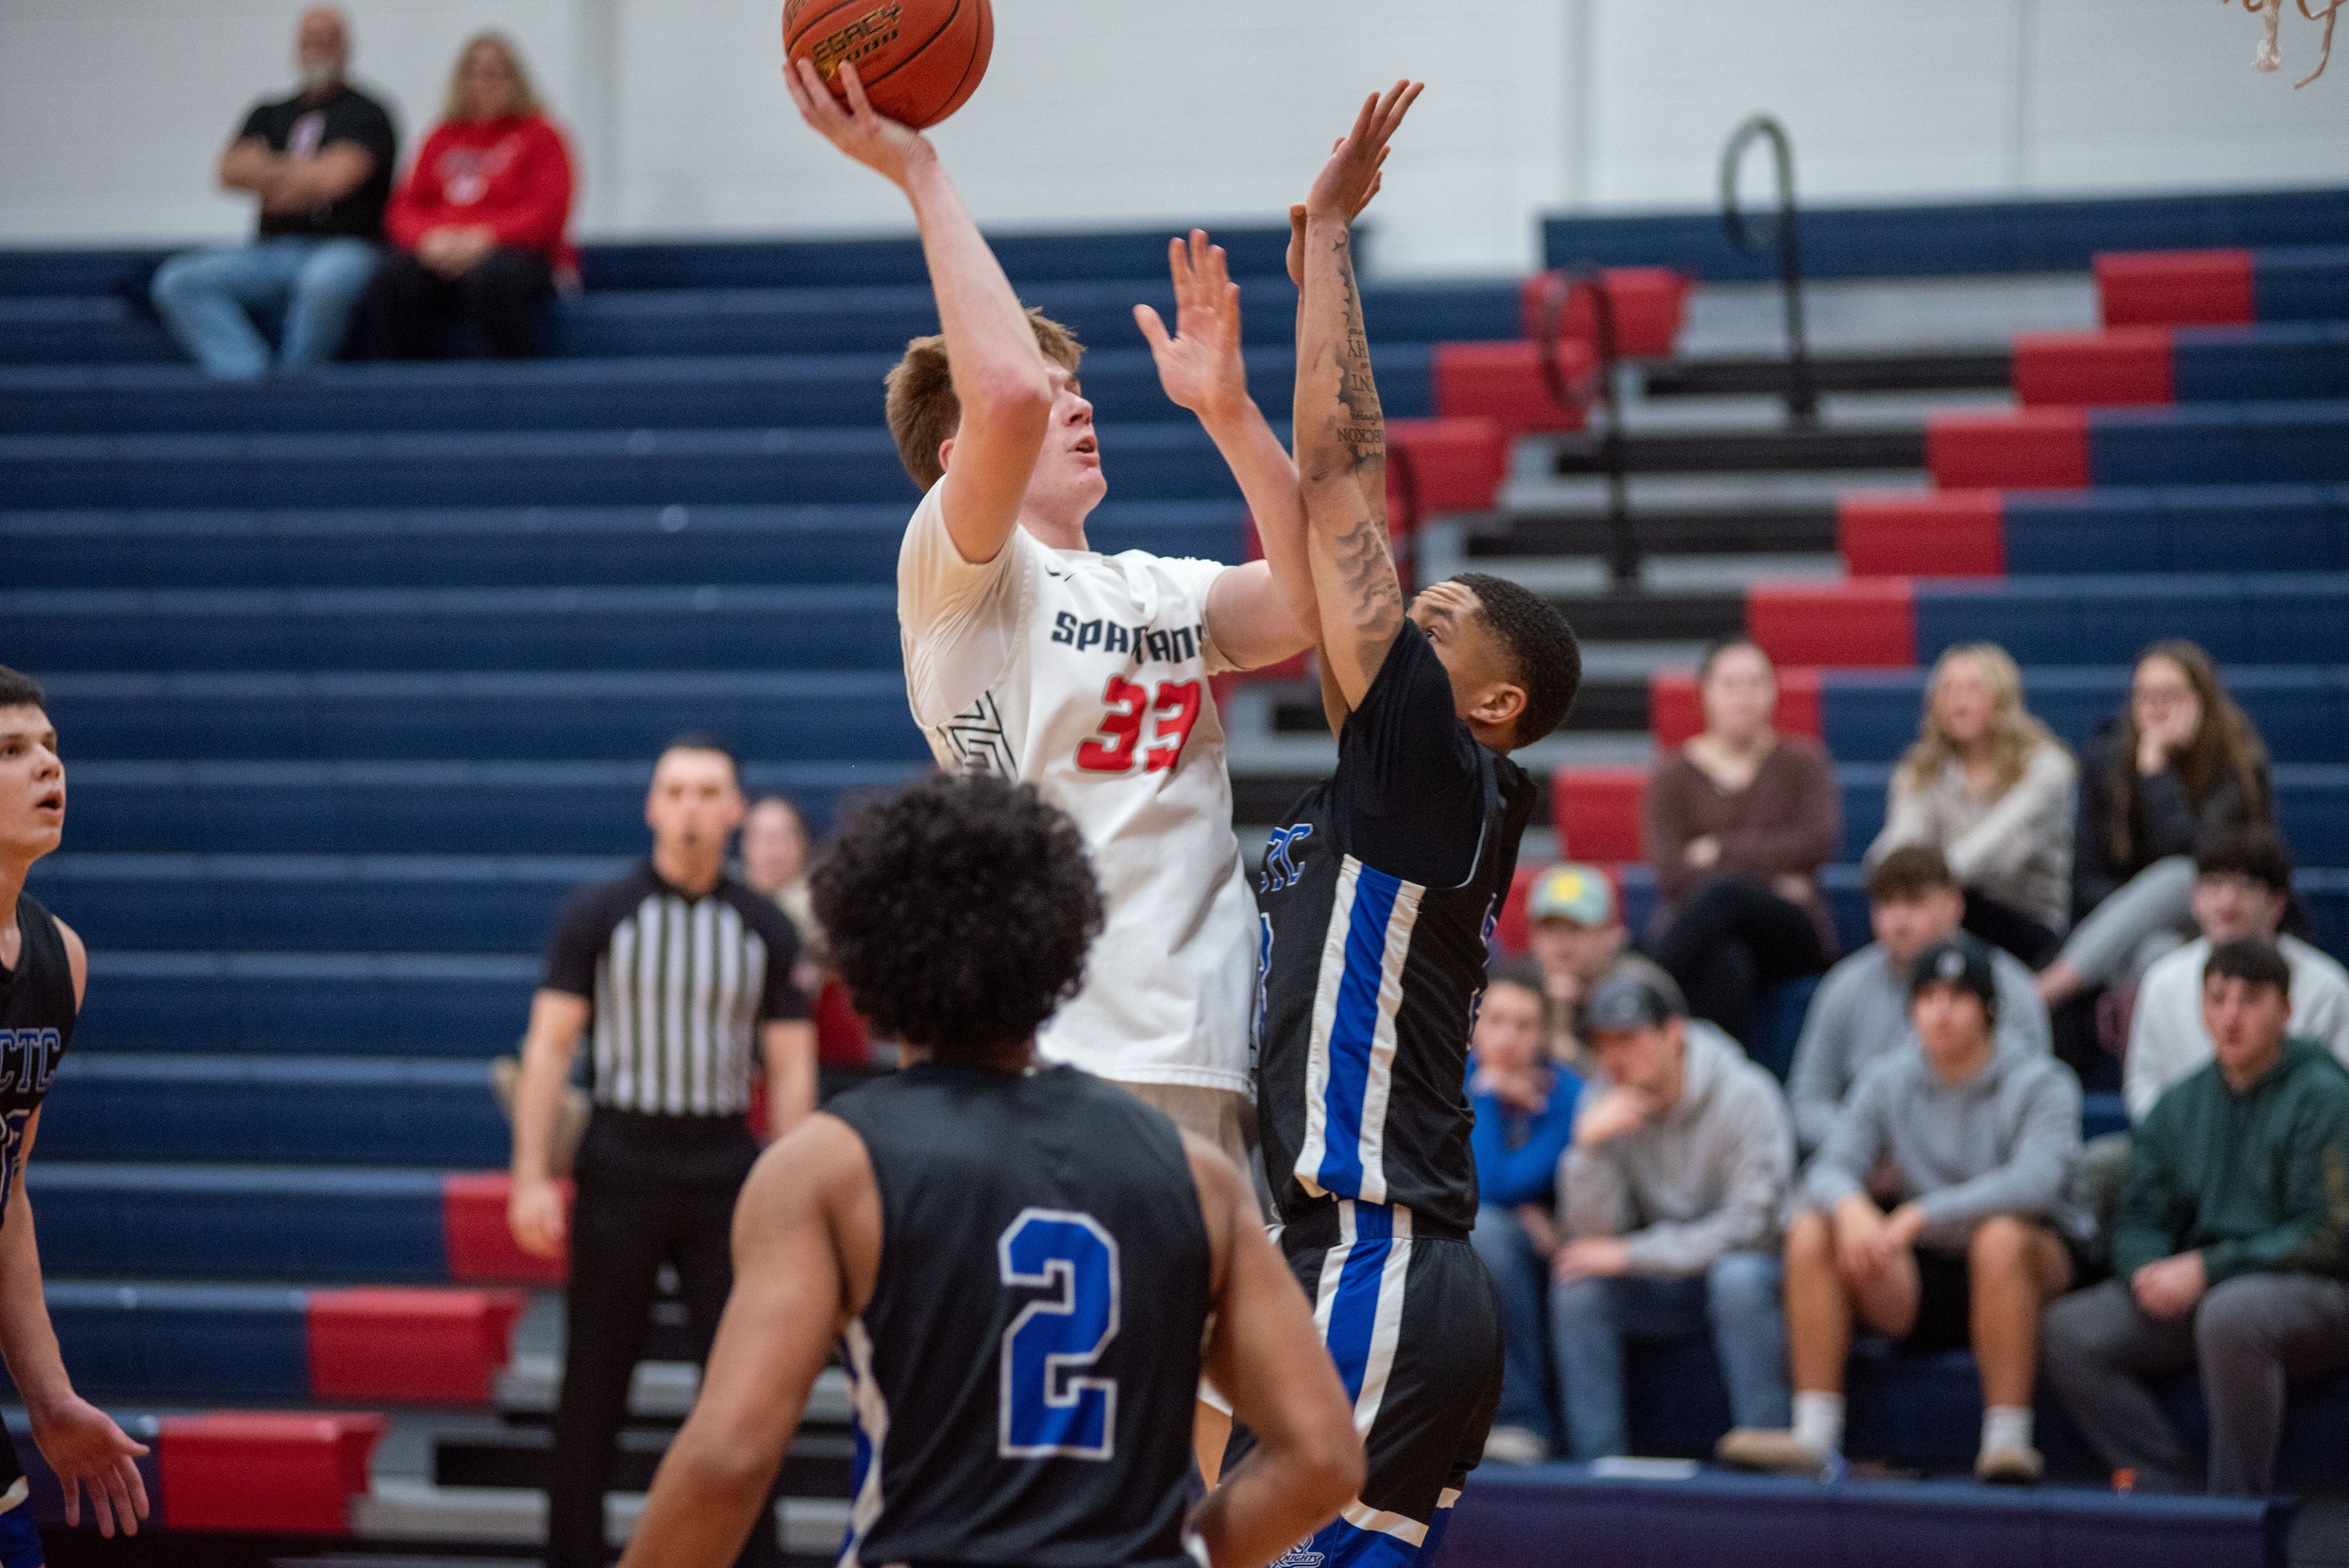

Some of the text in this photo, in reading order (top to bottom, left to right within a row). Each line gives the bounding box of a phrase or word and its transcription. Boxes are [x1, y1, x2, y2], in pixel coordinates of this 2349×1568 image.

[1051, 610, 1202, 665] SPARAN
[1074, 672, 1202, 774] 33
[998, 1207, 1121, 1461] 2
[1281, 1553, 1323, 1563] NIGHTS
